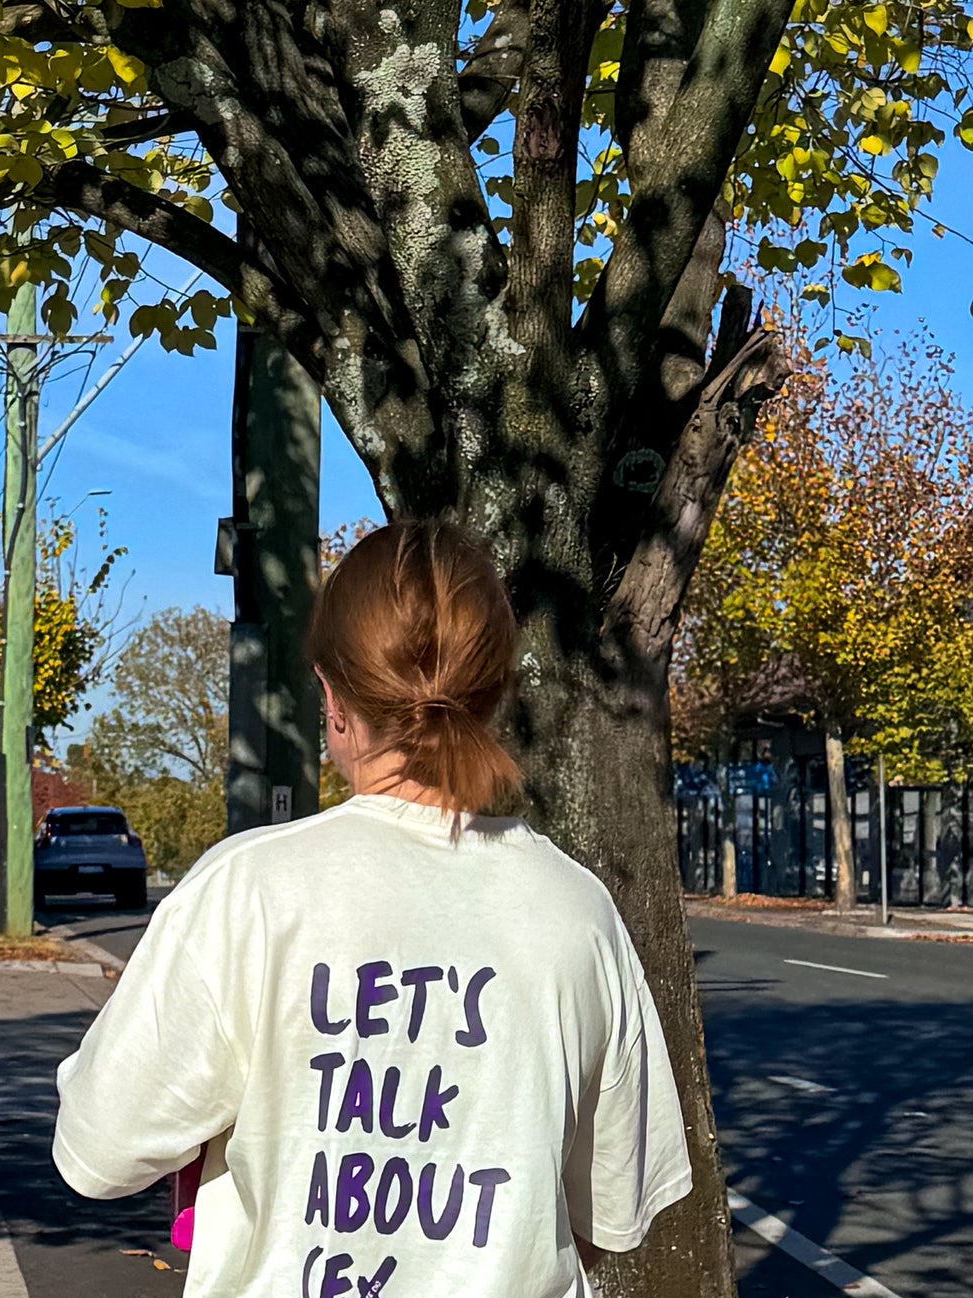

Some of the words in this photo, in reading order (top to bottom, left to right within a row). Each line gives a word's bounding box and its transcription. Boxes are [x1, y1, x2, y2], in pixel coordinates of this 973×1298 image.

[310, 961, 496, 1047] LET'S
[310, 1052, 459, 1142] TALK
[305, 1151, 511, 1248] ABOUT
